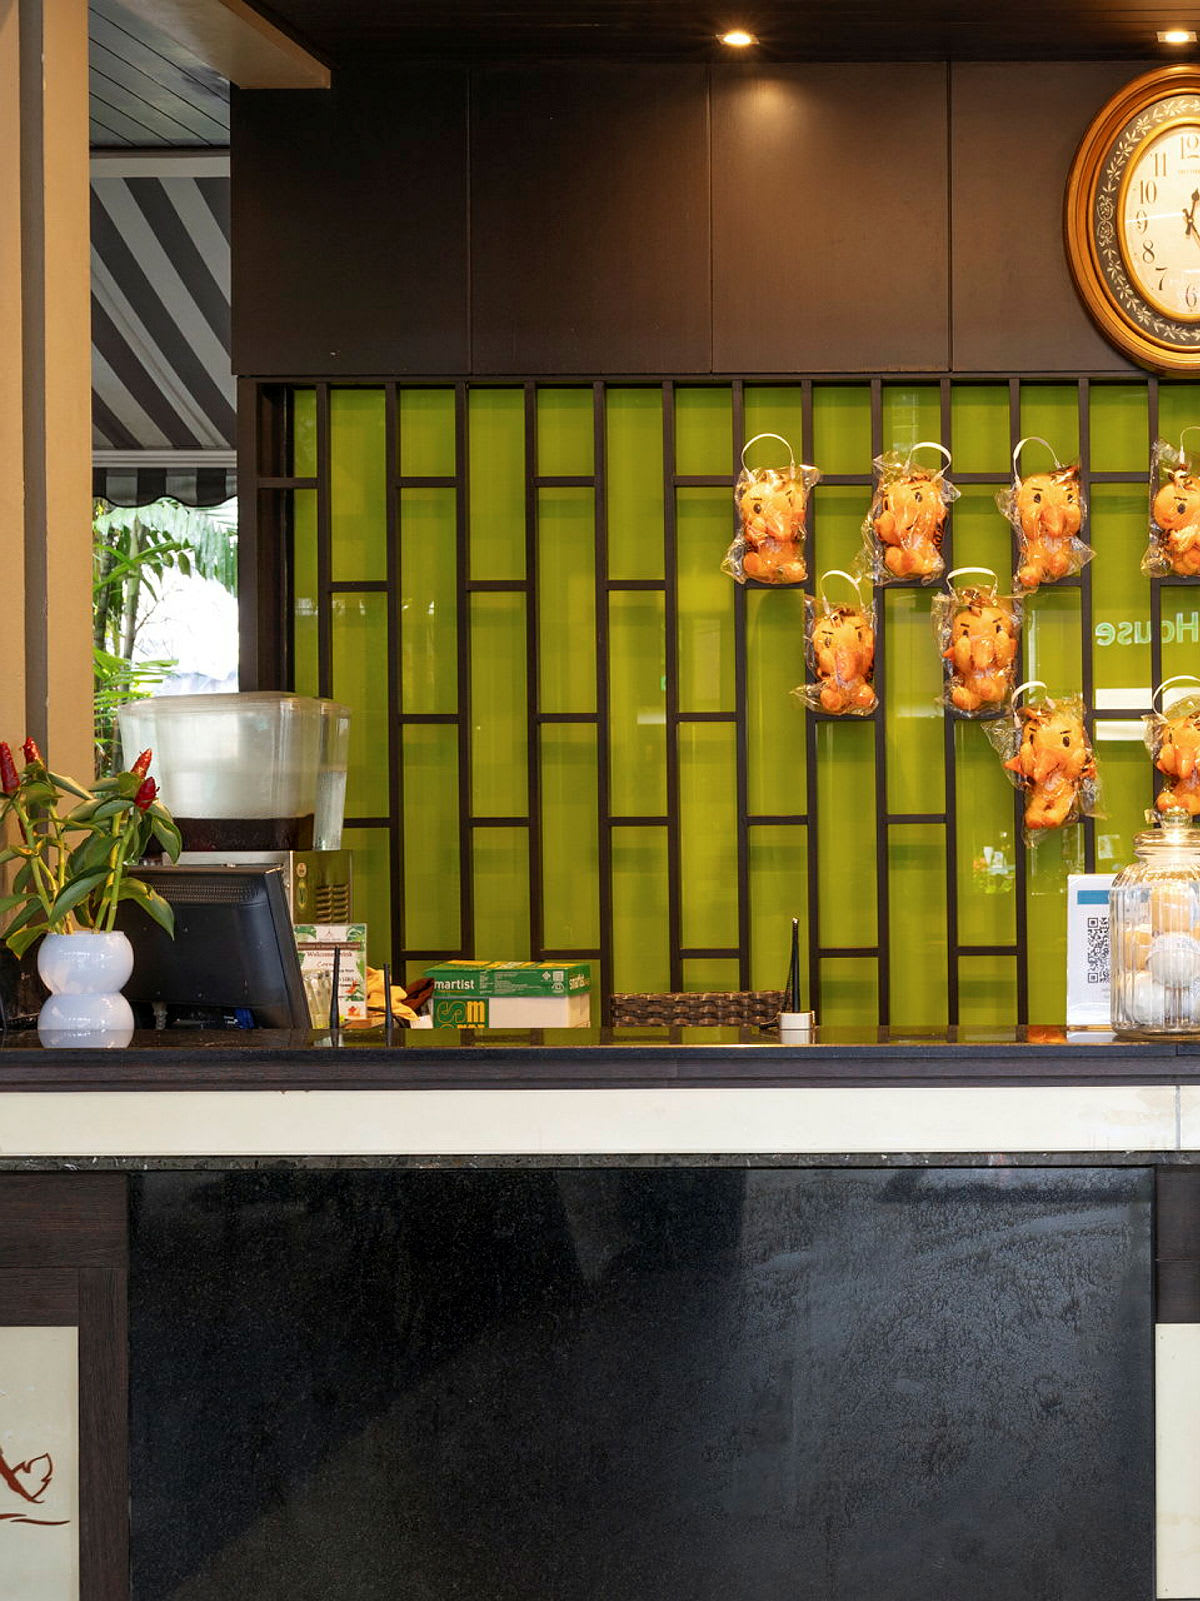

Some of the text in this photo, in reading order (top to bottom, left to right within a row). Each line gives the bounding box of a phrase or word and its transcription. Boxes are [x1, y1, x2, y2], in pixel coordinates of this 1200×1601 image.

[1179, 135, 1199, 160] 12
[1154, 152, 1167, 177] 11
[1139, 179, 1157, 204] 10
[1136, 210, 1148, 234] 9
[1142, 239, 1155, 264] 8
[1155, 267, 1168, 291] 7
[1184, 284, 1197, 307] 6
